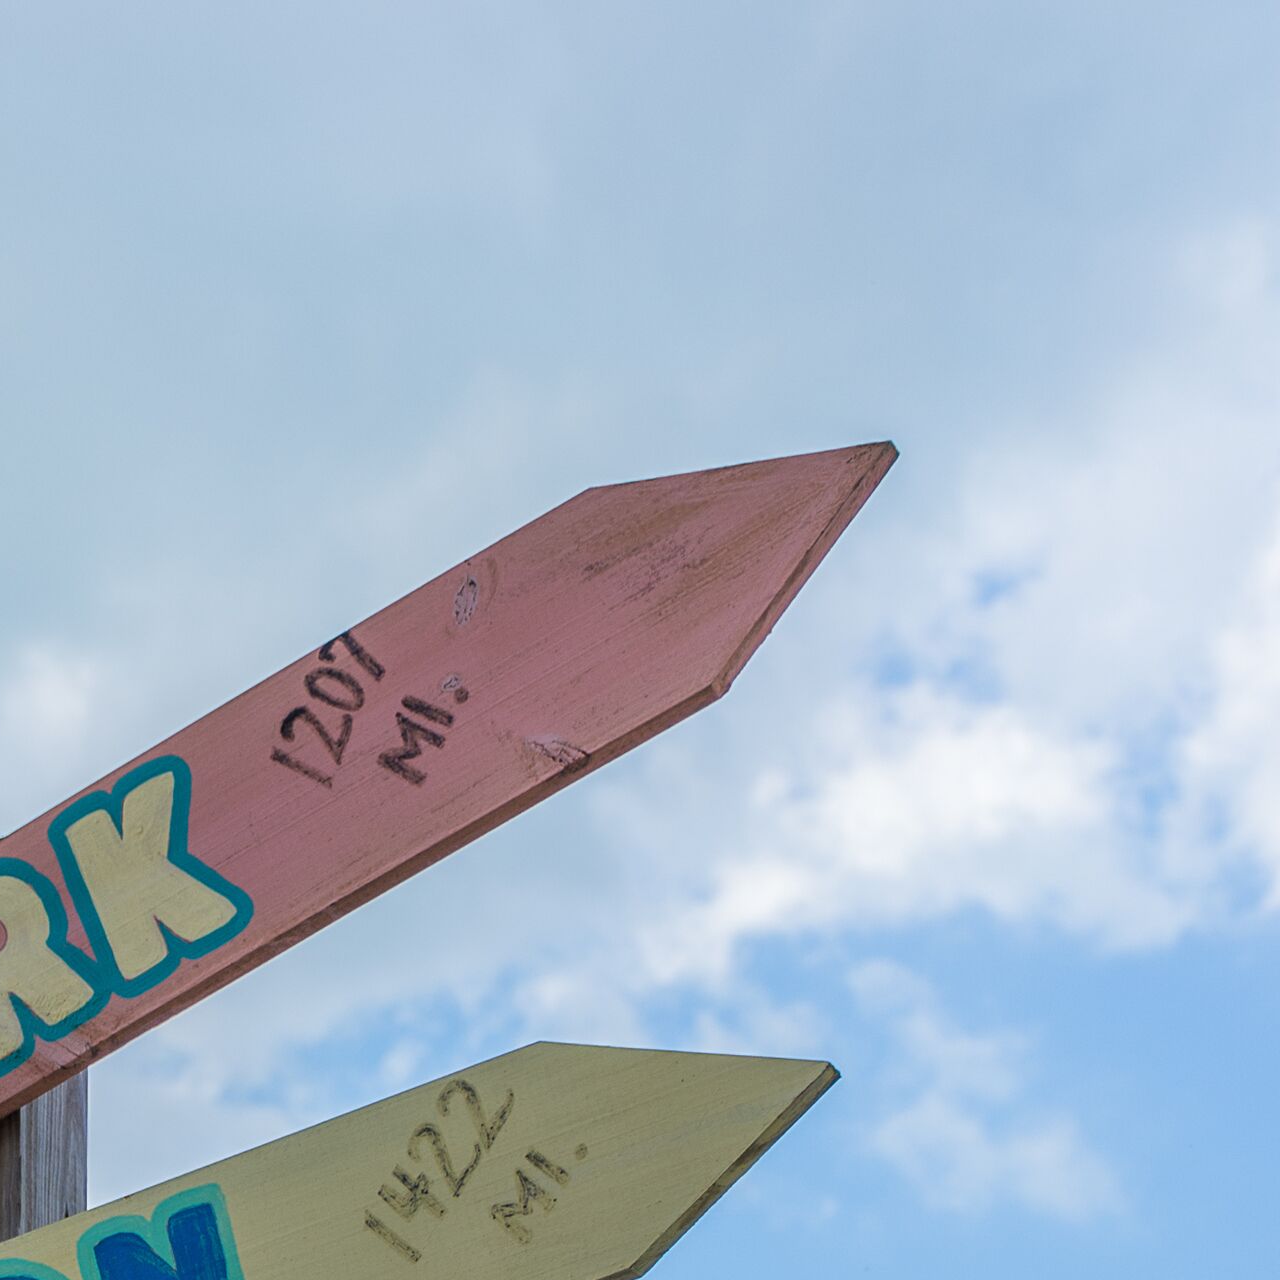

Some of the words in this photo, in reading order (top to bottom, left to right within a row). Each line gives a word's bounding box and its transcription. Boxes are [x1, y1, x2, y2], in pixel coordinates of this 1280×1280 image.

[270, 629, 386, 788] 1207
[378, 686, 469, 786] MI.
[364, 1078, 514, 1263] 1422
